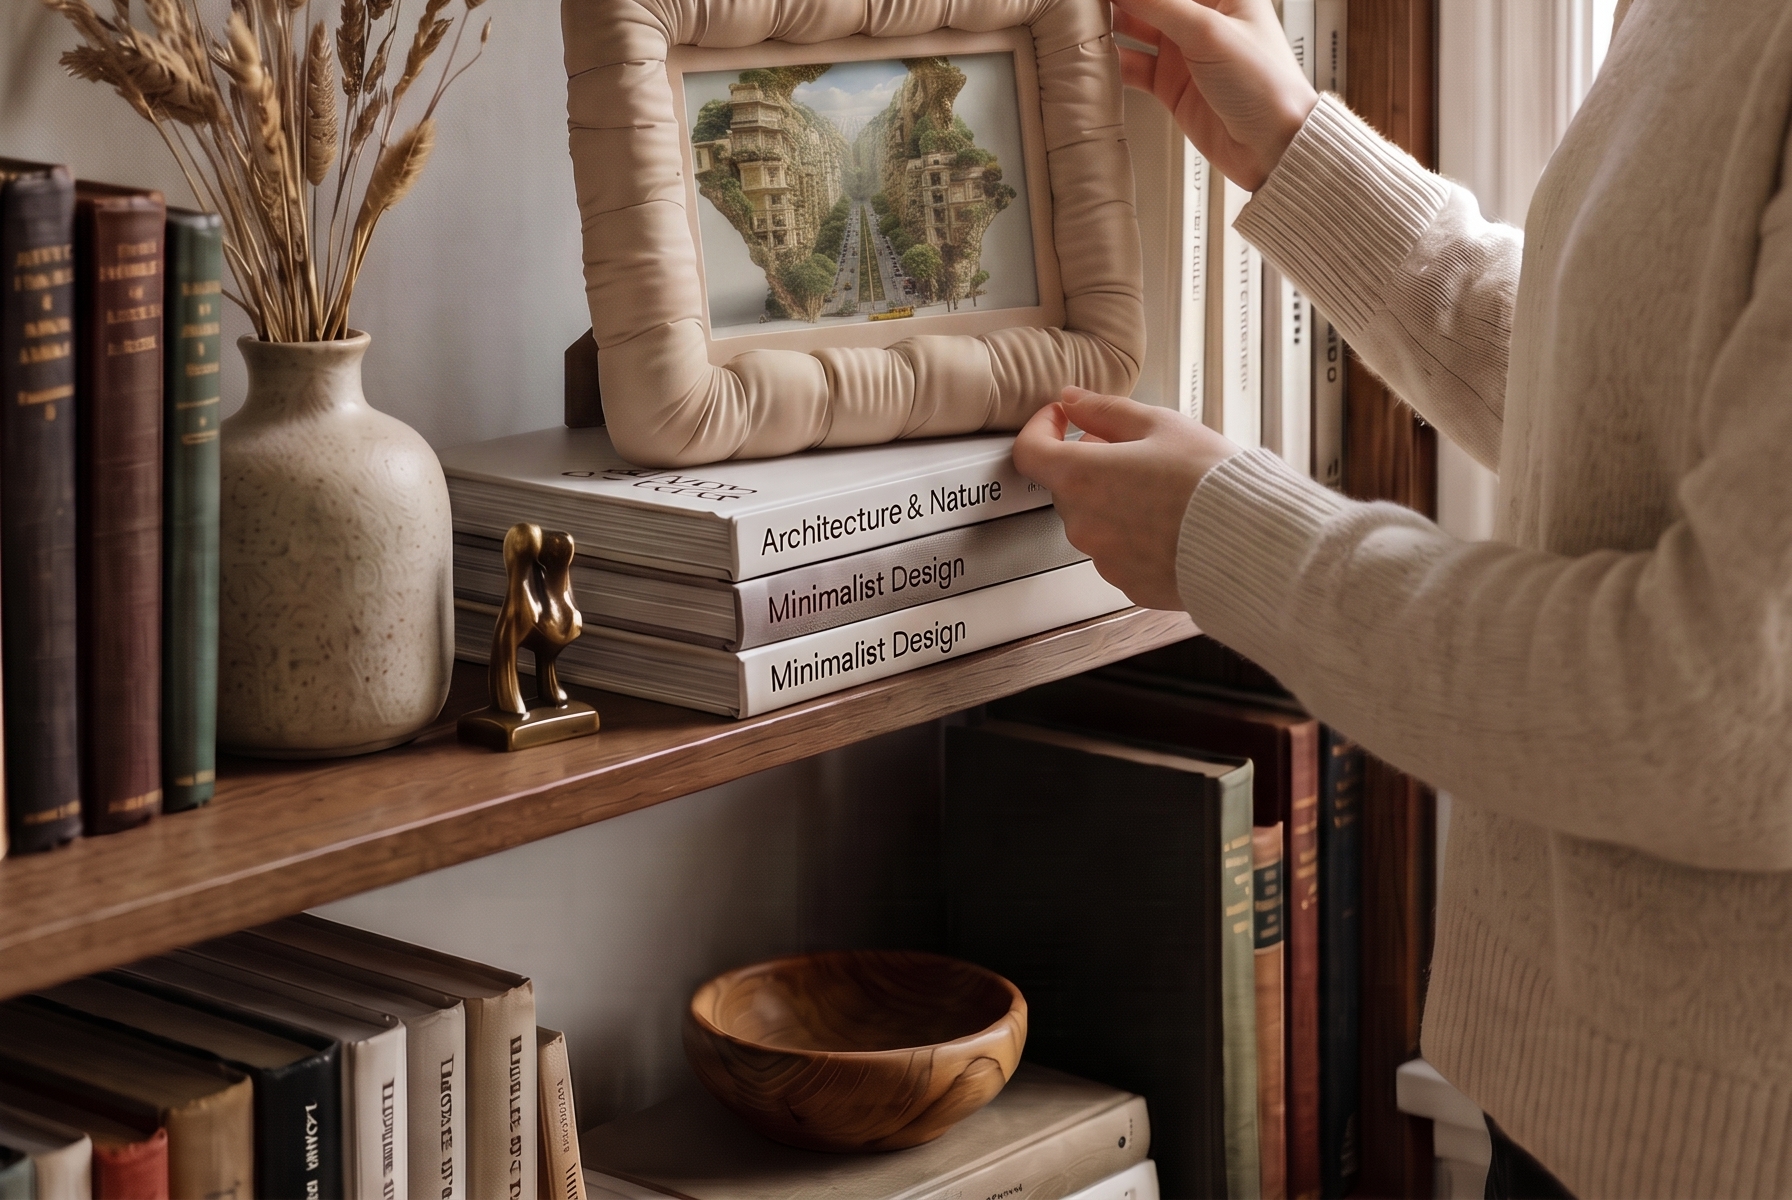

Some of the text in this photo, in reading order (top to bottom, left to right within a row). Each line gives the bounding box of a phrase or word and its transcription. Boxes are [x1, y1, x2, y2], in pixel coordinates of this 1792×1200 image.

[761, 480, 1002, 555] Architecture & Nature
[768, 556, 965, 623] Minimalist Design
[771, 620, 966, 692] Minimalist Design
